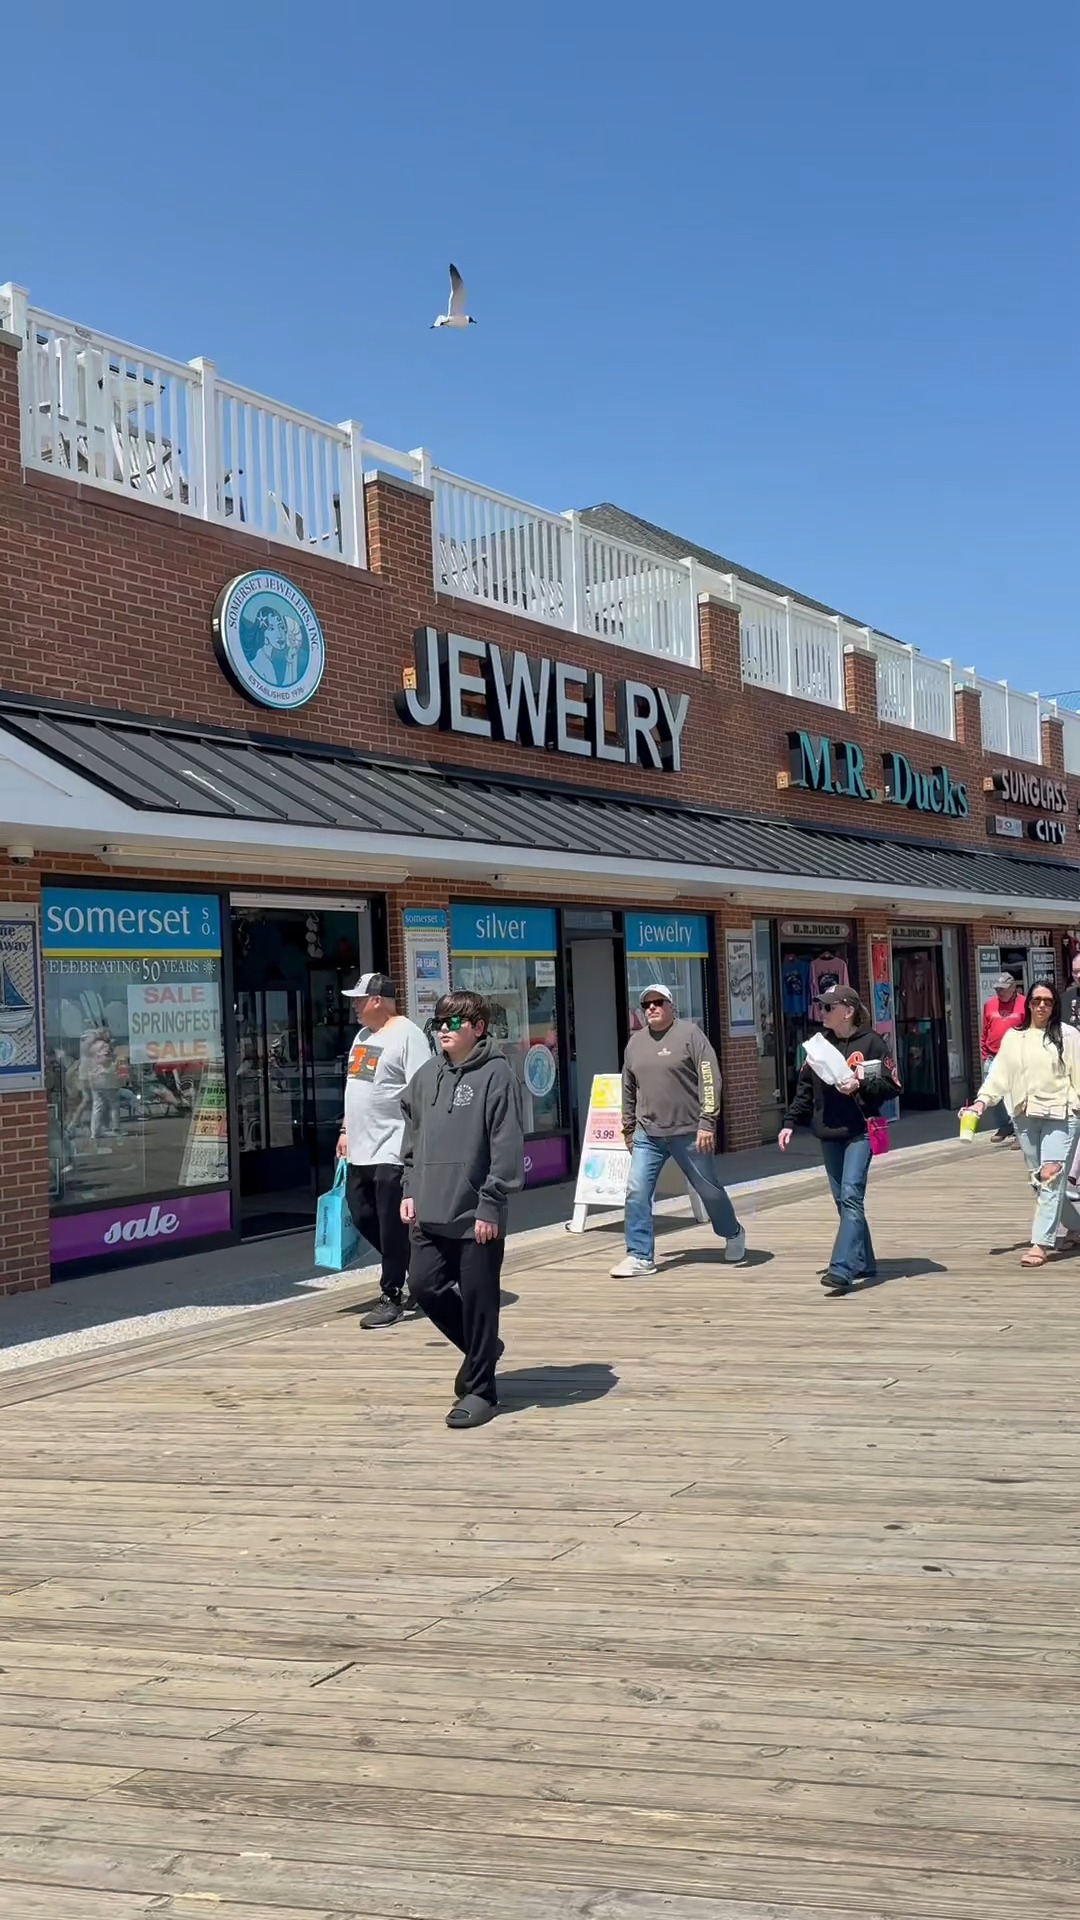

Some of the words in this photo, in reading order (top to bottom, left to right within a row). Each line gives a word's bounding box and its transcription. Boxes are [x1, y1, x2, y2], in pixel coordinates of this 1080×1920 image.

[228, 577, 262, 629] SOMERSET
[248, 674, 290, 699] ESTABLISHED
[402, 626, 691, 772] JEWELRY
[796, 730, 878, 800] M.R.
[891, 752, 969, 818] Ducks
[1001, 768, 1068, 813] SUNGLASS
[1036, 820, 1066, 844] CITY
[47, 906, 191, 935] somerset
[405, 914, 439, 924] somerset
[476, 913, 527, 940] silver
[639, 921, 692, 947] jewelry
[1032, 930, 1051, 946] CITY
[142, 958, 160, 982] 50
[162, 960, 200, 973] YEARS
[144, 987, 205, 1004] SALE
[132, 1010, 218, 1034] SPRINGFEST
[146, 1039, 208, 1059] SALE
[103, 1205, 180, 1244] sale
